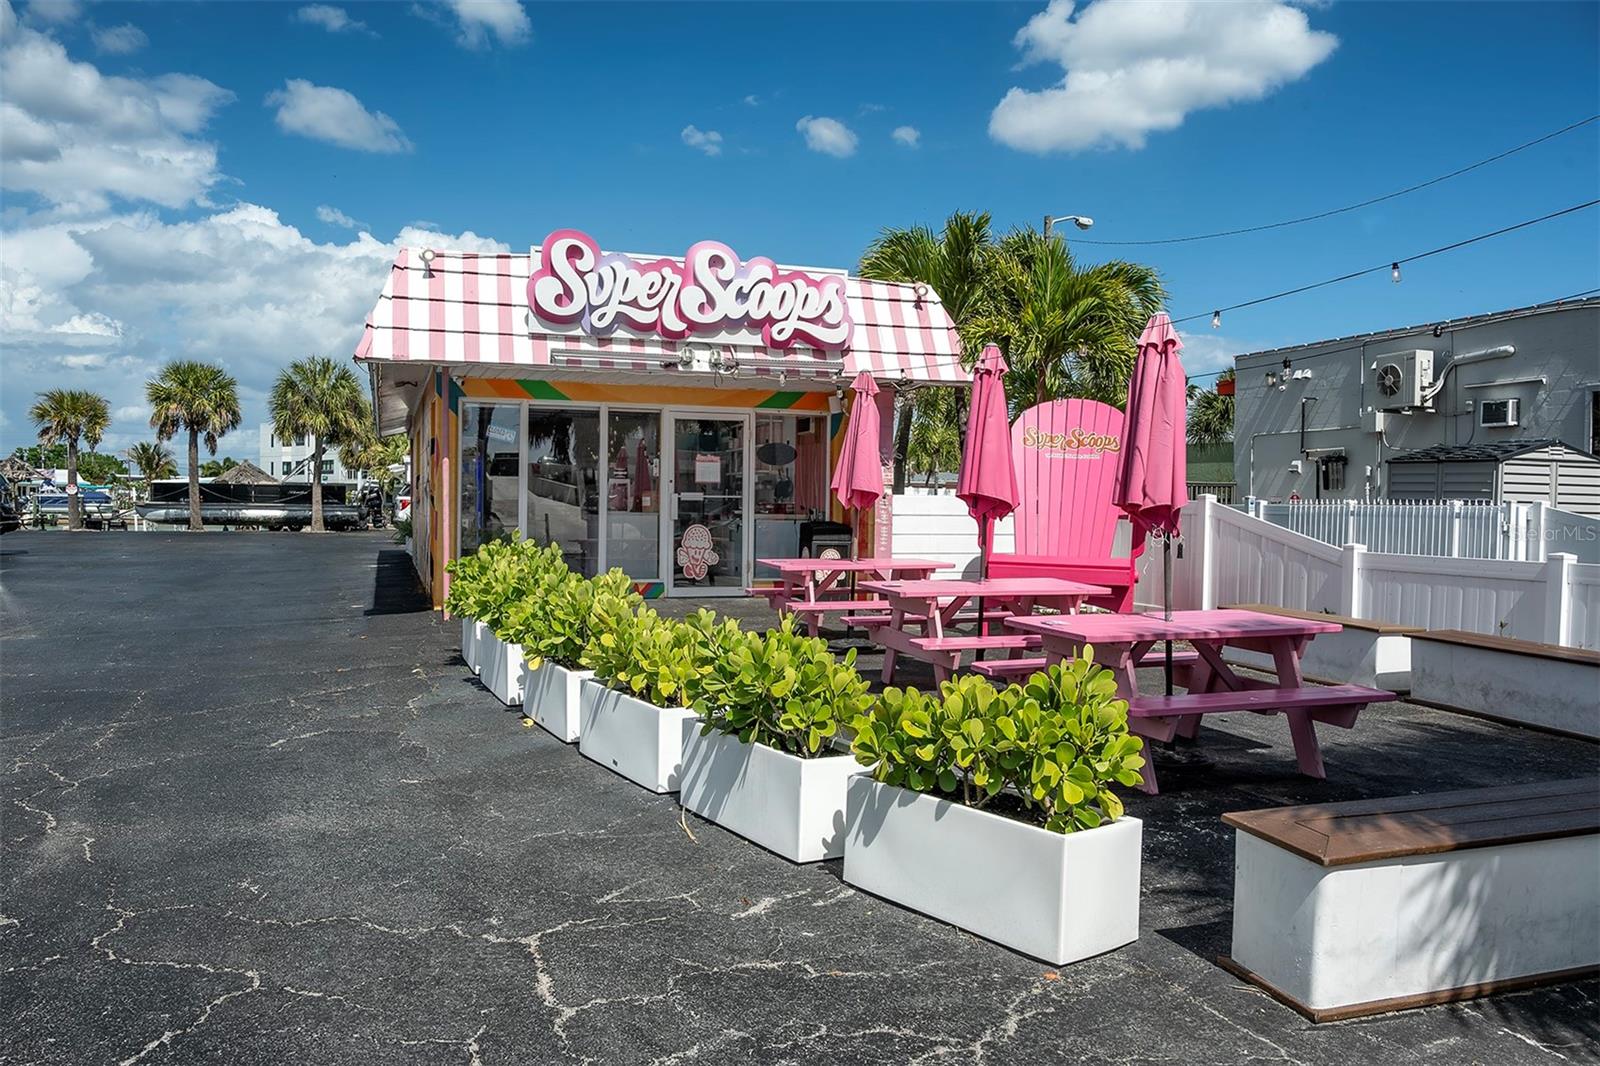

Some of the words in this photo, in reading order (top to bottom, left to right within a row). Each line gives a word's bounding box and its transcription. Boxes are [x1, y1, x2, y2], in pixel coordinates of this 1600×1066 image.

[535, 237, 688, 332] Super
[680, 247, 850, 343] Scoops
[1023, 426, 1067, 451] Super
[1066, 428, 1121, 454] Scoops
